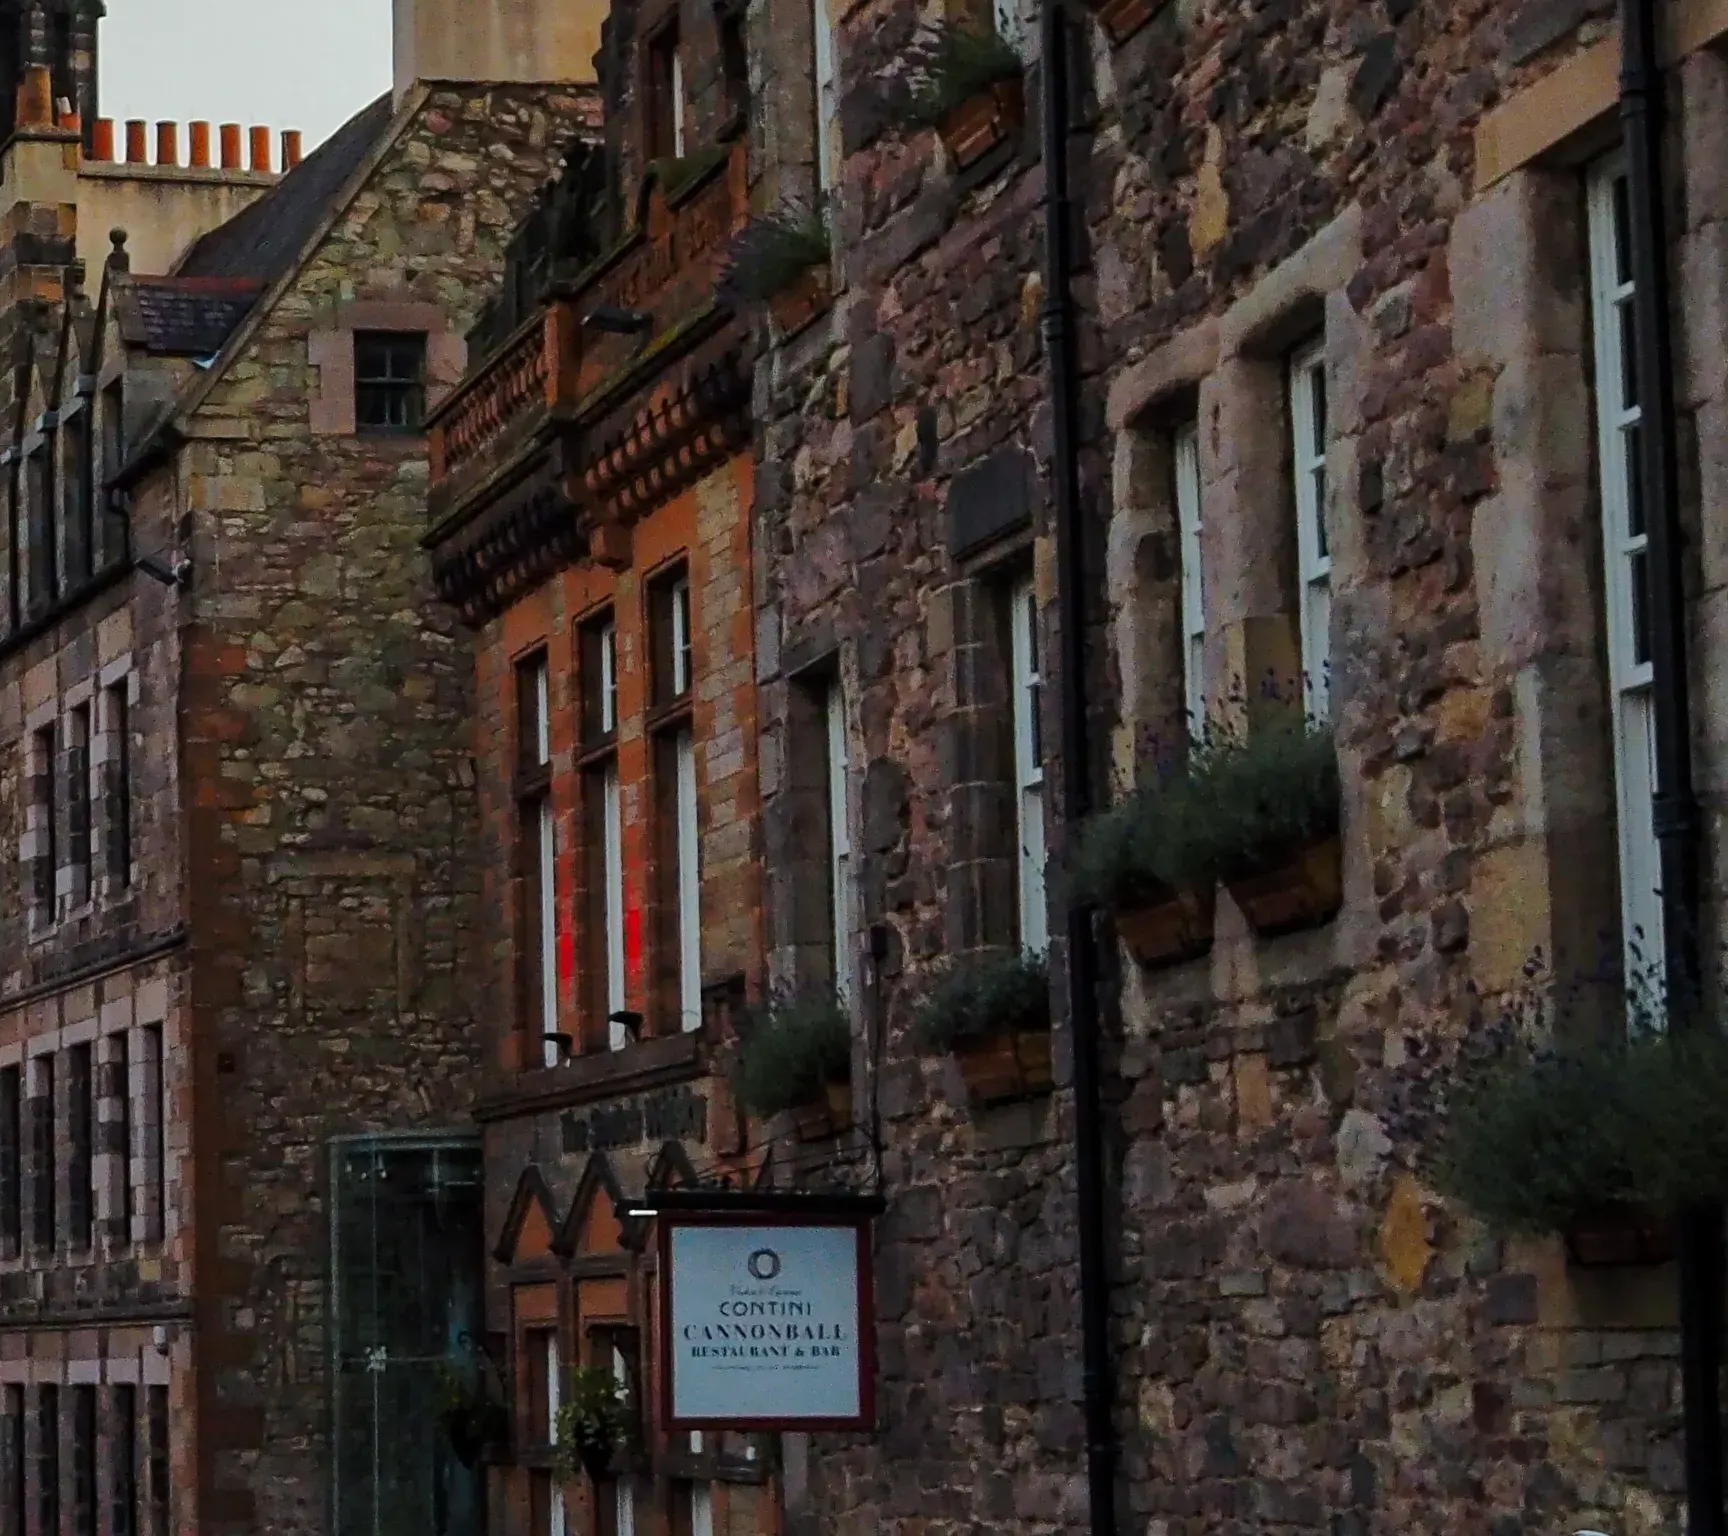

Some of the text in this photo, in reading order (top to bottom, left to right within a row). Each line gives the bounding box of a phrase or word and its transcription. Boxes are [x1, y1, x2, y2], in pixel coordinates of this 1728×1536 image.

[719, 1300, 812, 1317] CONTINI
[683, 1322, 848, 1341] CANNONBALL
[691, 1344, 842, 1358] RESTAURANT & BAR
